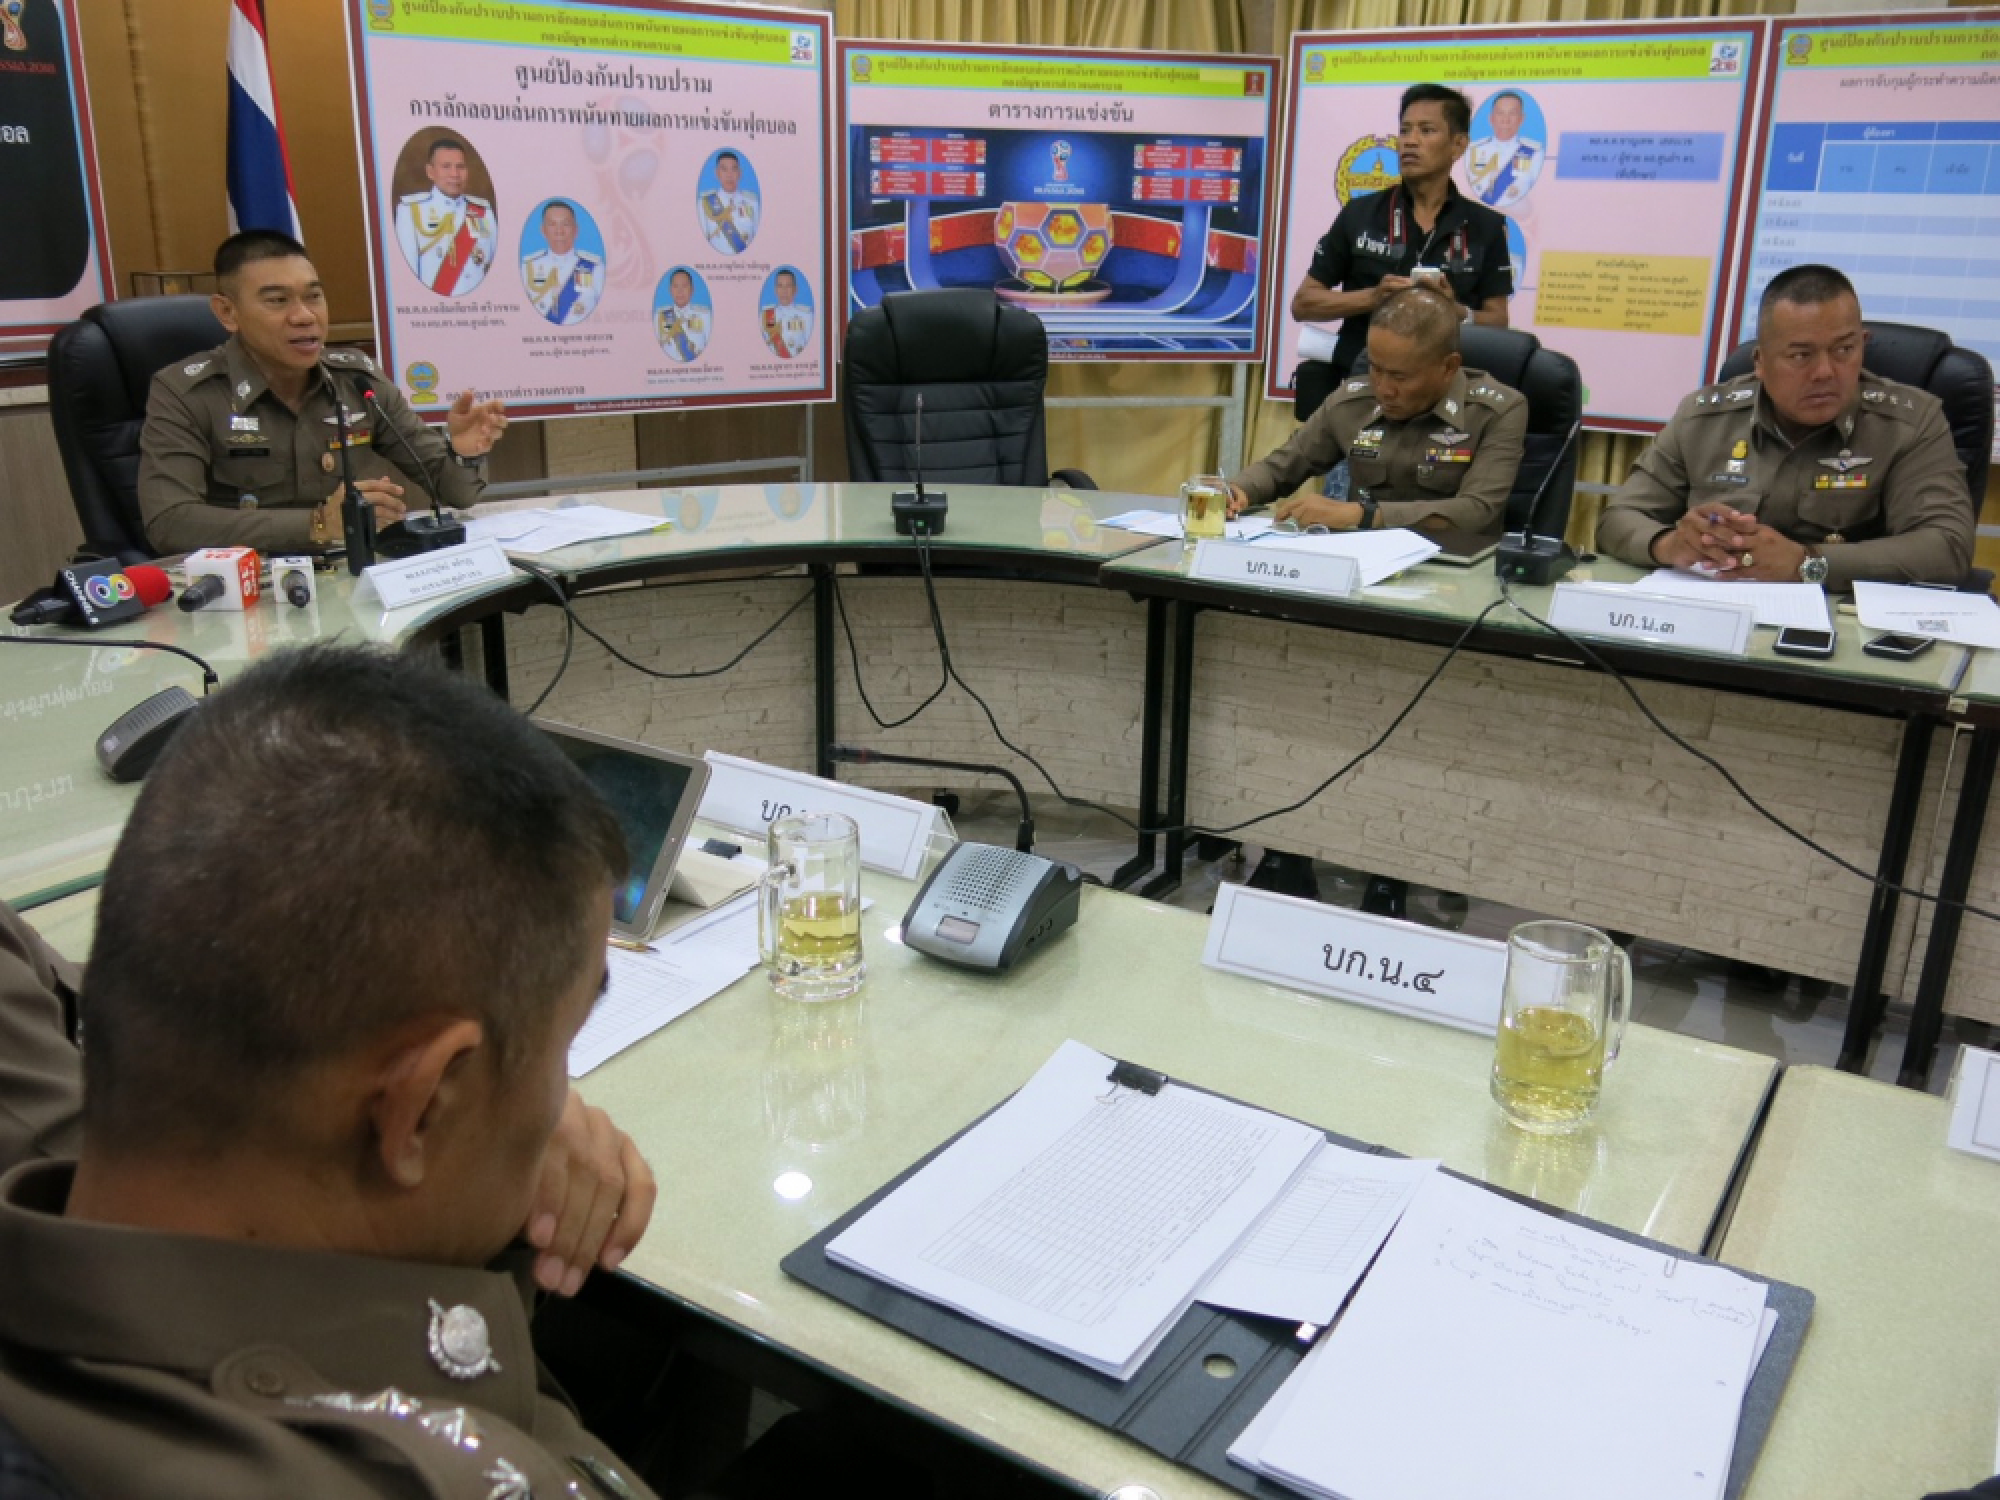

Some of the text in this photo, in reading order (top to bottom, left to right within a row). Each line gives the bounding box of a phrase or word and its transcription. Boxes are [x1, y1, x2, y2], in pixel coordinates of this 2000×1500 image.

[515, 56, 713, 93] ศูนย์ป้องกันปราบปราม
[410, 92, 797, 140] การลักลอบเล่นการพนันทายผลการแข่งขันฟุตบอล
[989, 101, 1134, 124] ตารางการแข่งขัน
[1608, 611, 1676, 634] บก.น.๓
[1322, 942, 1445, 995] บก.น.๔
